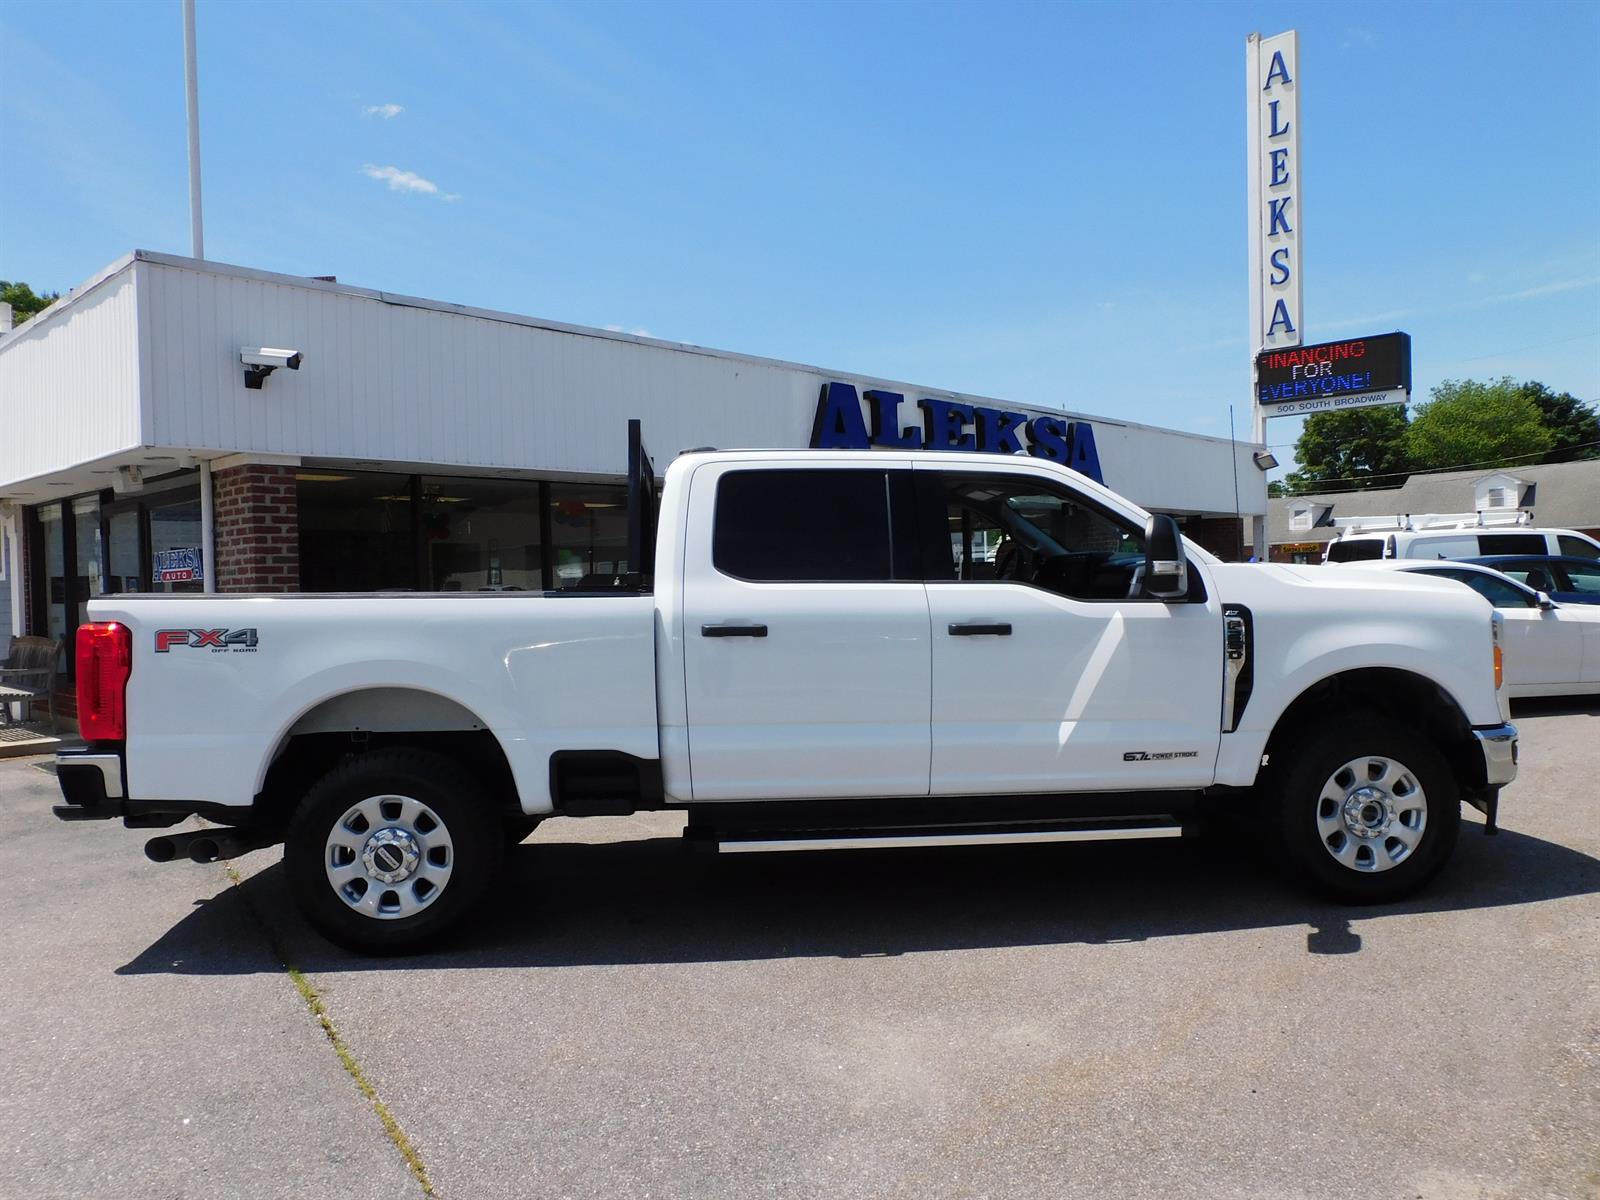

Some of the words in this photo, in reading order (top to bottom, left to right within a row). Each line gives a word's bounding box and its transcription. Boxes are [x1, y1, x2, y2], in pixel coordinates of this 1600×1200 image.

[1263, 50, 1296, 337] ALEKSA
[1292, 361, 1333, 380] FOR
[1277, 405, 1295, 413] 500
[1300, 401, 1331, 410] SOUTH
[1334, 394, 1387, 406] BROADWAY
[809, 382, 1108, 488] ALEKSA
[152, 547, 204, 583] ALEKSA
[165, 572, 187, 580] AUTO
[155, 628, 259, 653] FX4
[1123, 752, 1151, 761] 6.7L
